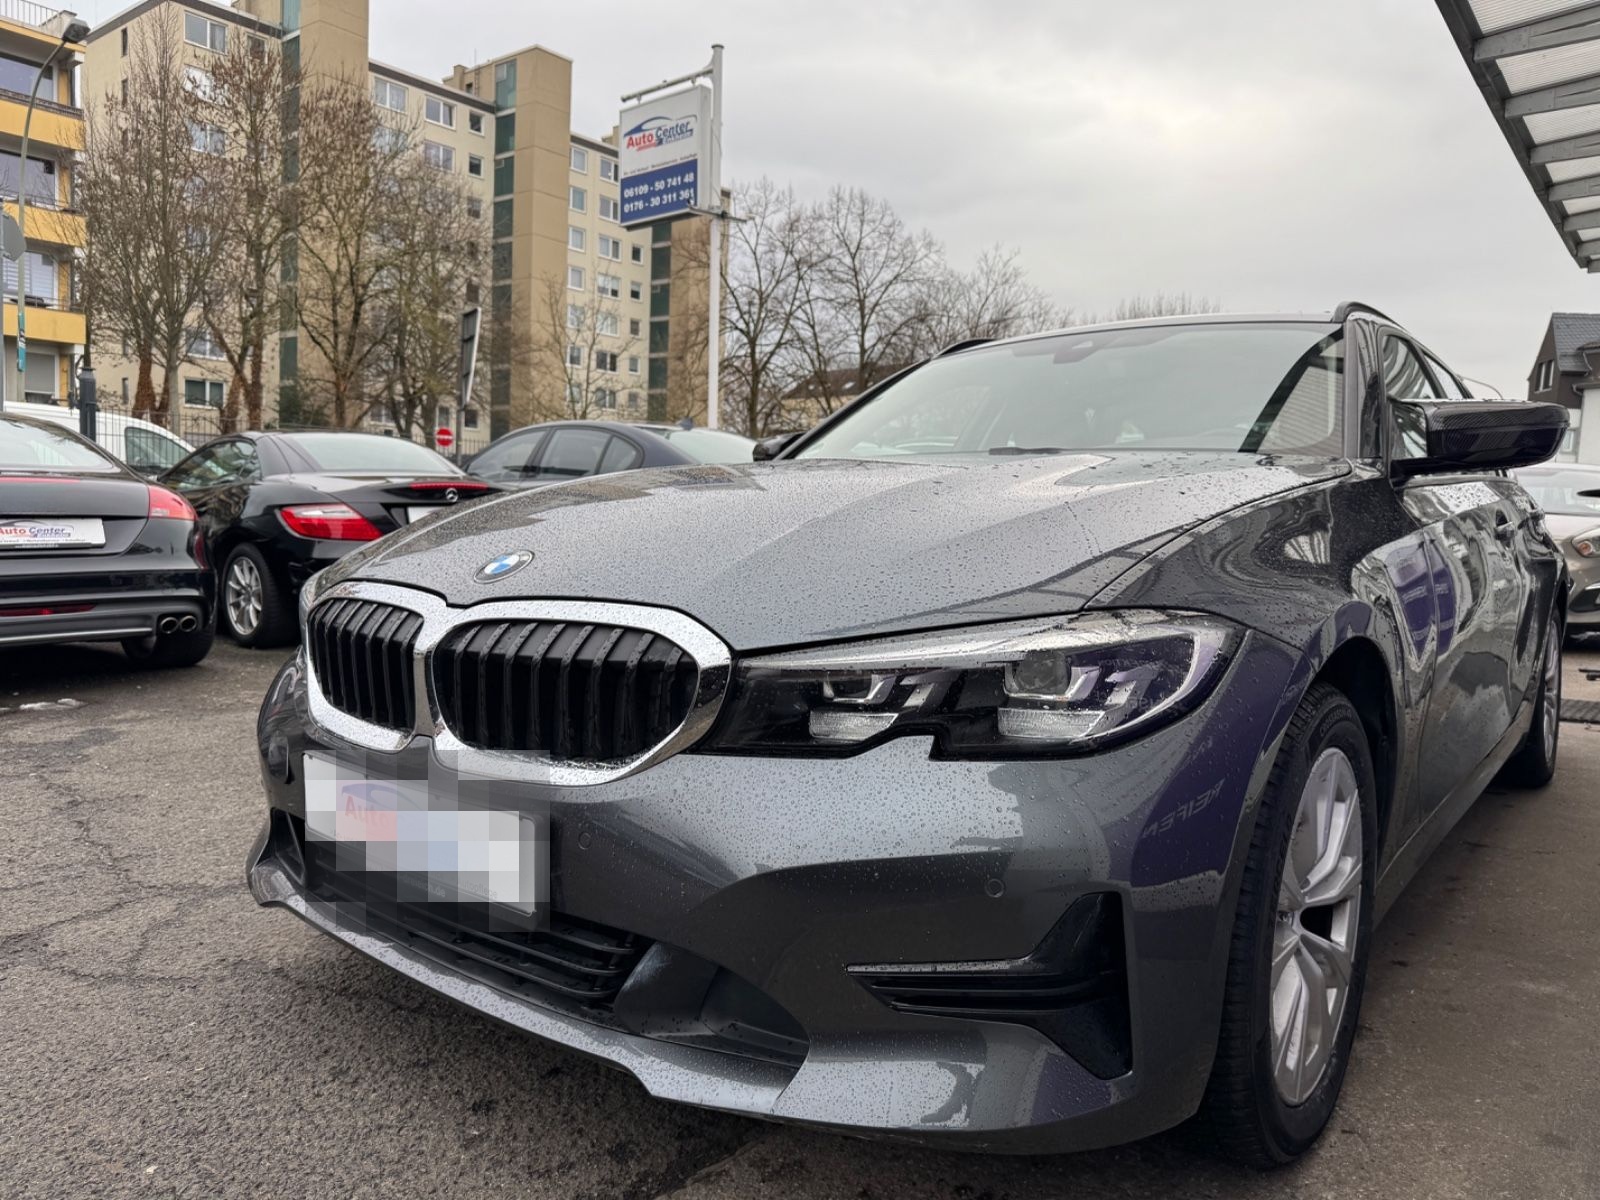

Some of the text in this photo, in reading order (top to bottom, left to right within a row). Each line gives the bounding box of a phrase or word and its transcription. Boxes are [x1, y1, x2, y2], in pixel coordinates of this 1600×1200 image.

[626, 132, 654, 149] Auto
[656, 122, 691, 139] Center
[667, 176, 681, 187] 741
[662, 192, 677, 204] 311
[0, 526, 65, 535] Auto Center
